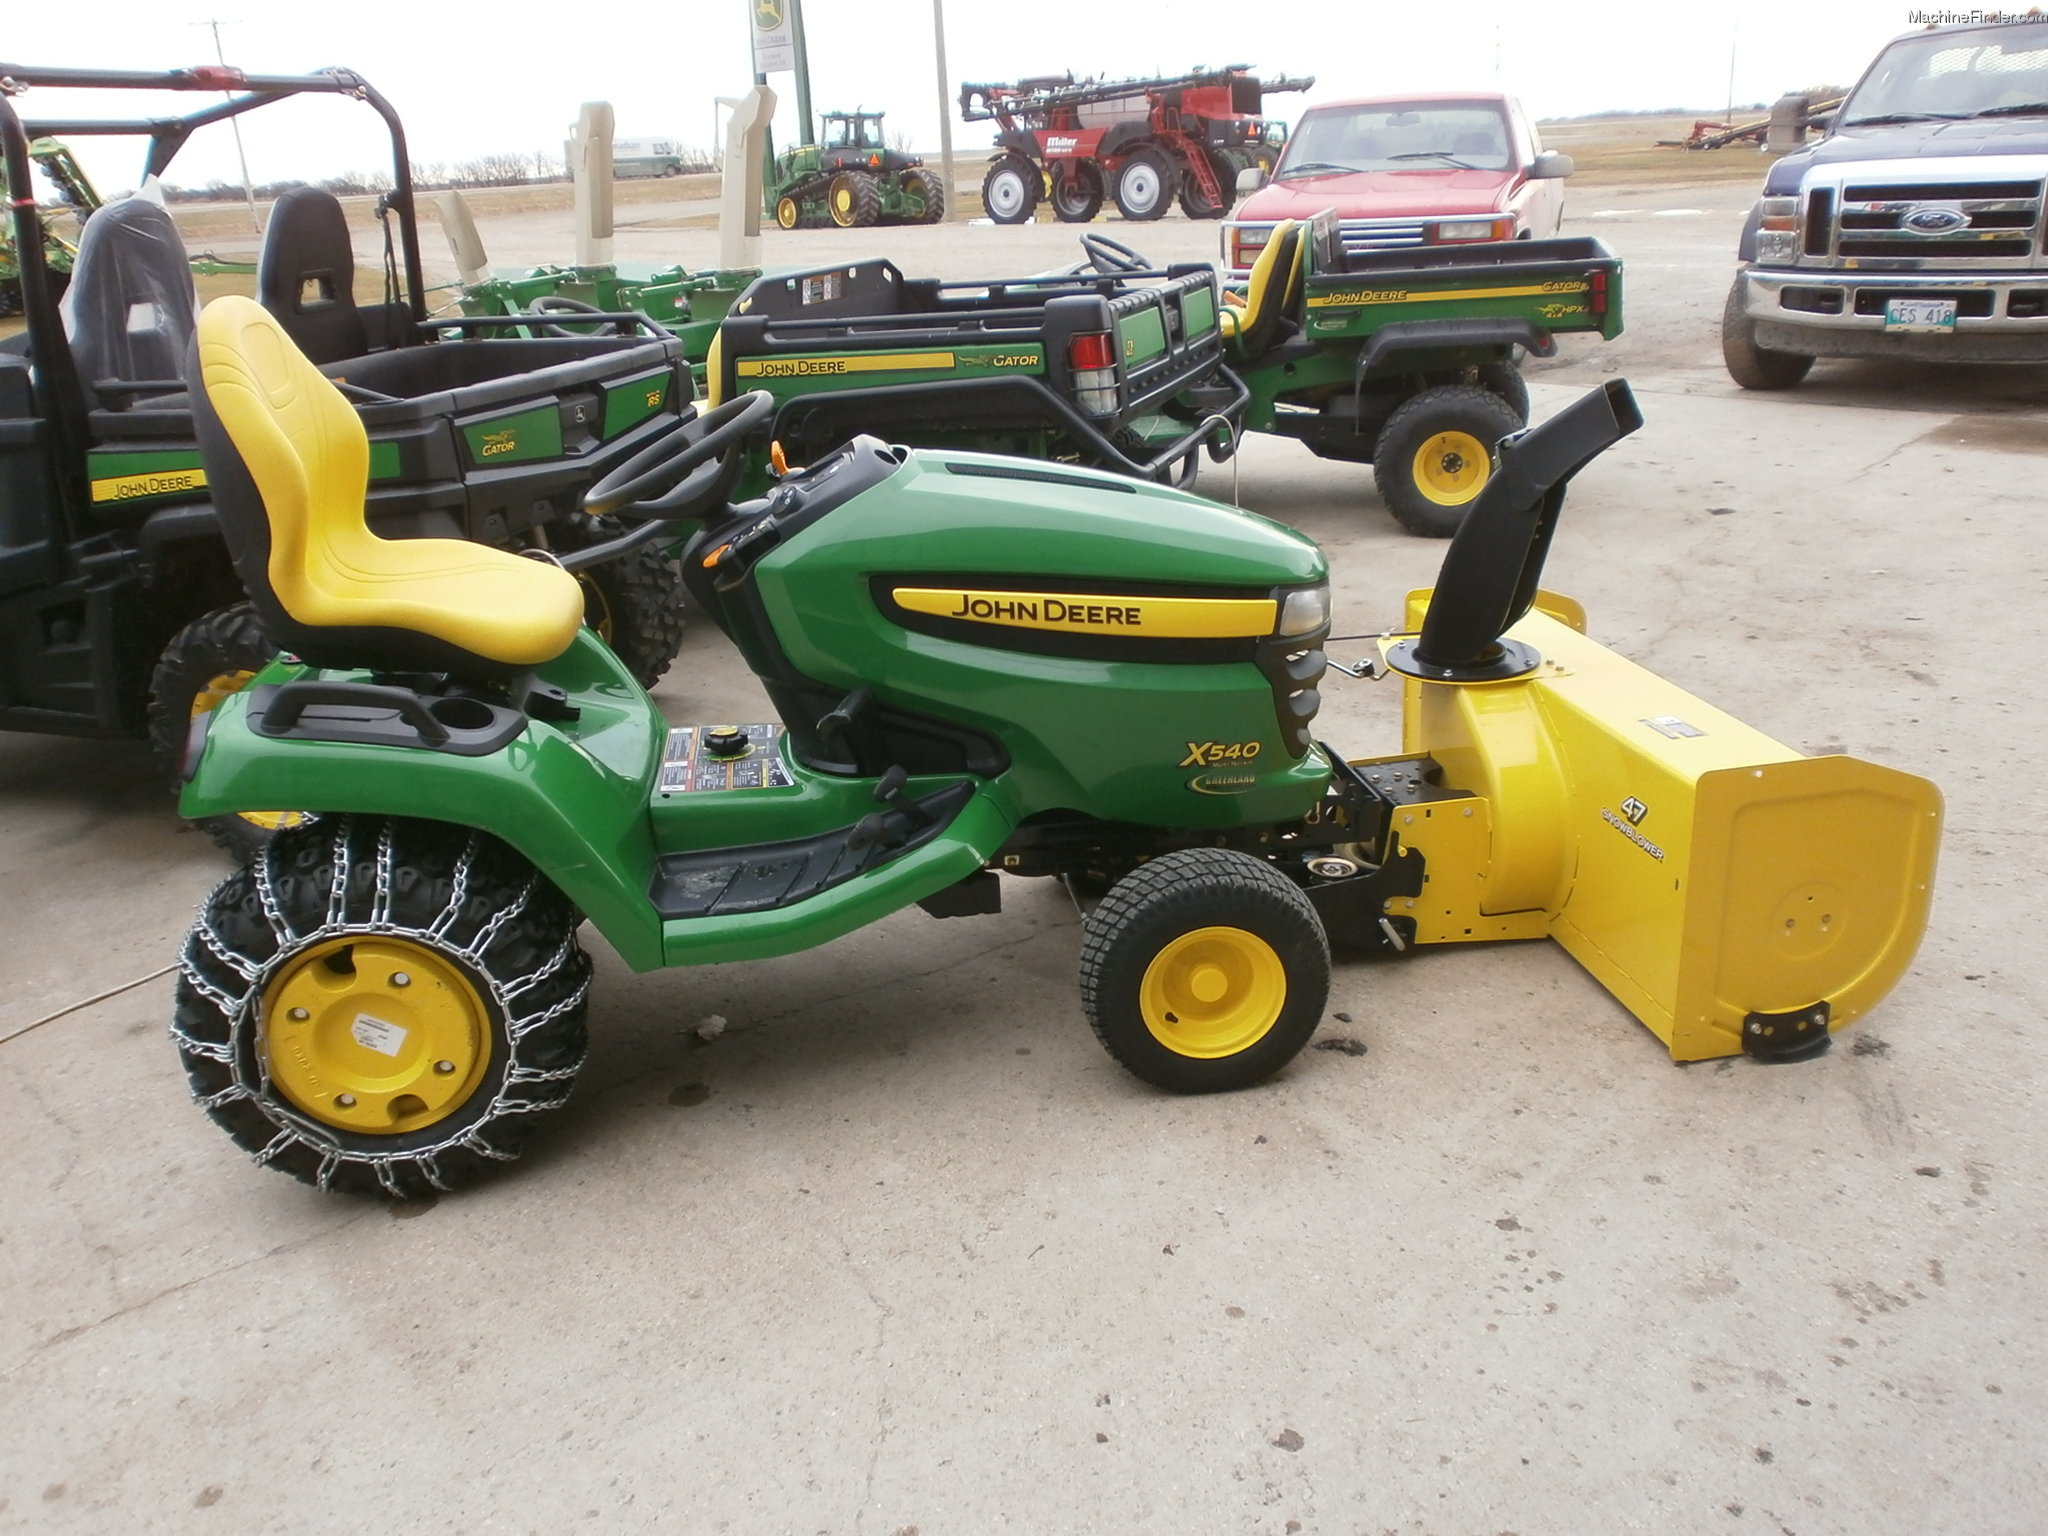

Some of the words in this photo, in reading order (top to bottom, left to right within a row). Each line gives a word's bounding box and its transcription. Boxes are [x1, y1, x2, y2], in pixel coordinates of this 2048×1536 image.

[1323, 292, 1360, 304] JOHN
[1361, 290, 1407, 301] DEERE
[1561, 305, 1584, 313] HPX
[1890, 307, 1917, 323] CES
[1925, 308, 1953, 324] 418
[757, 362, 795, 375] JOHN
[798, 360, 846, 374] DEERE
[993, 355, 1039, 367] GATOR
[482, 441, 515, 457] GATOR
[114, 482, 148, 498] JOHN
[149, 476, 193, 492] DEERE
[951, 594, 1038, 621] JOHN
[1043, 599, 1141, 626] DEERE
[1179, 741, 1261, 767] X540
[1205, 774, 1256, 785] GREENLAND
[1620, 796, 1648, 826] 47
[1601, 807, 1665, 863] SNOWBLOWER
